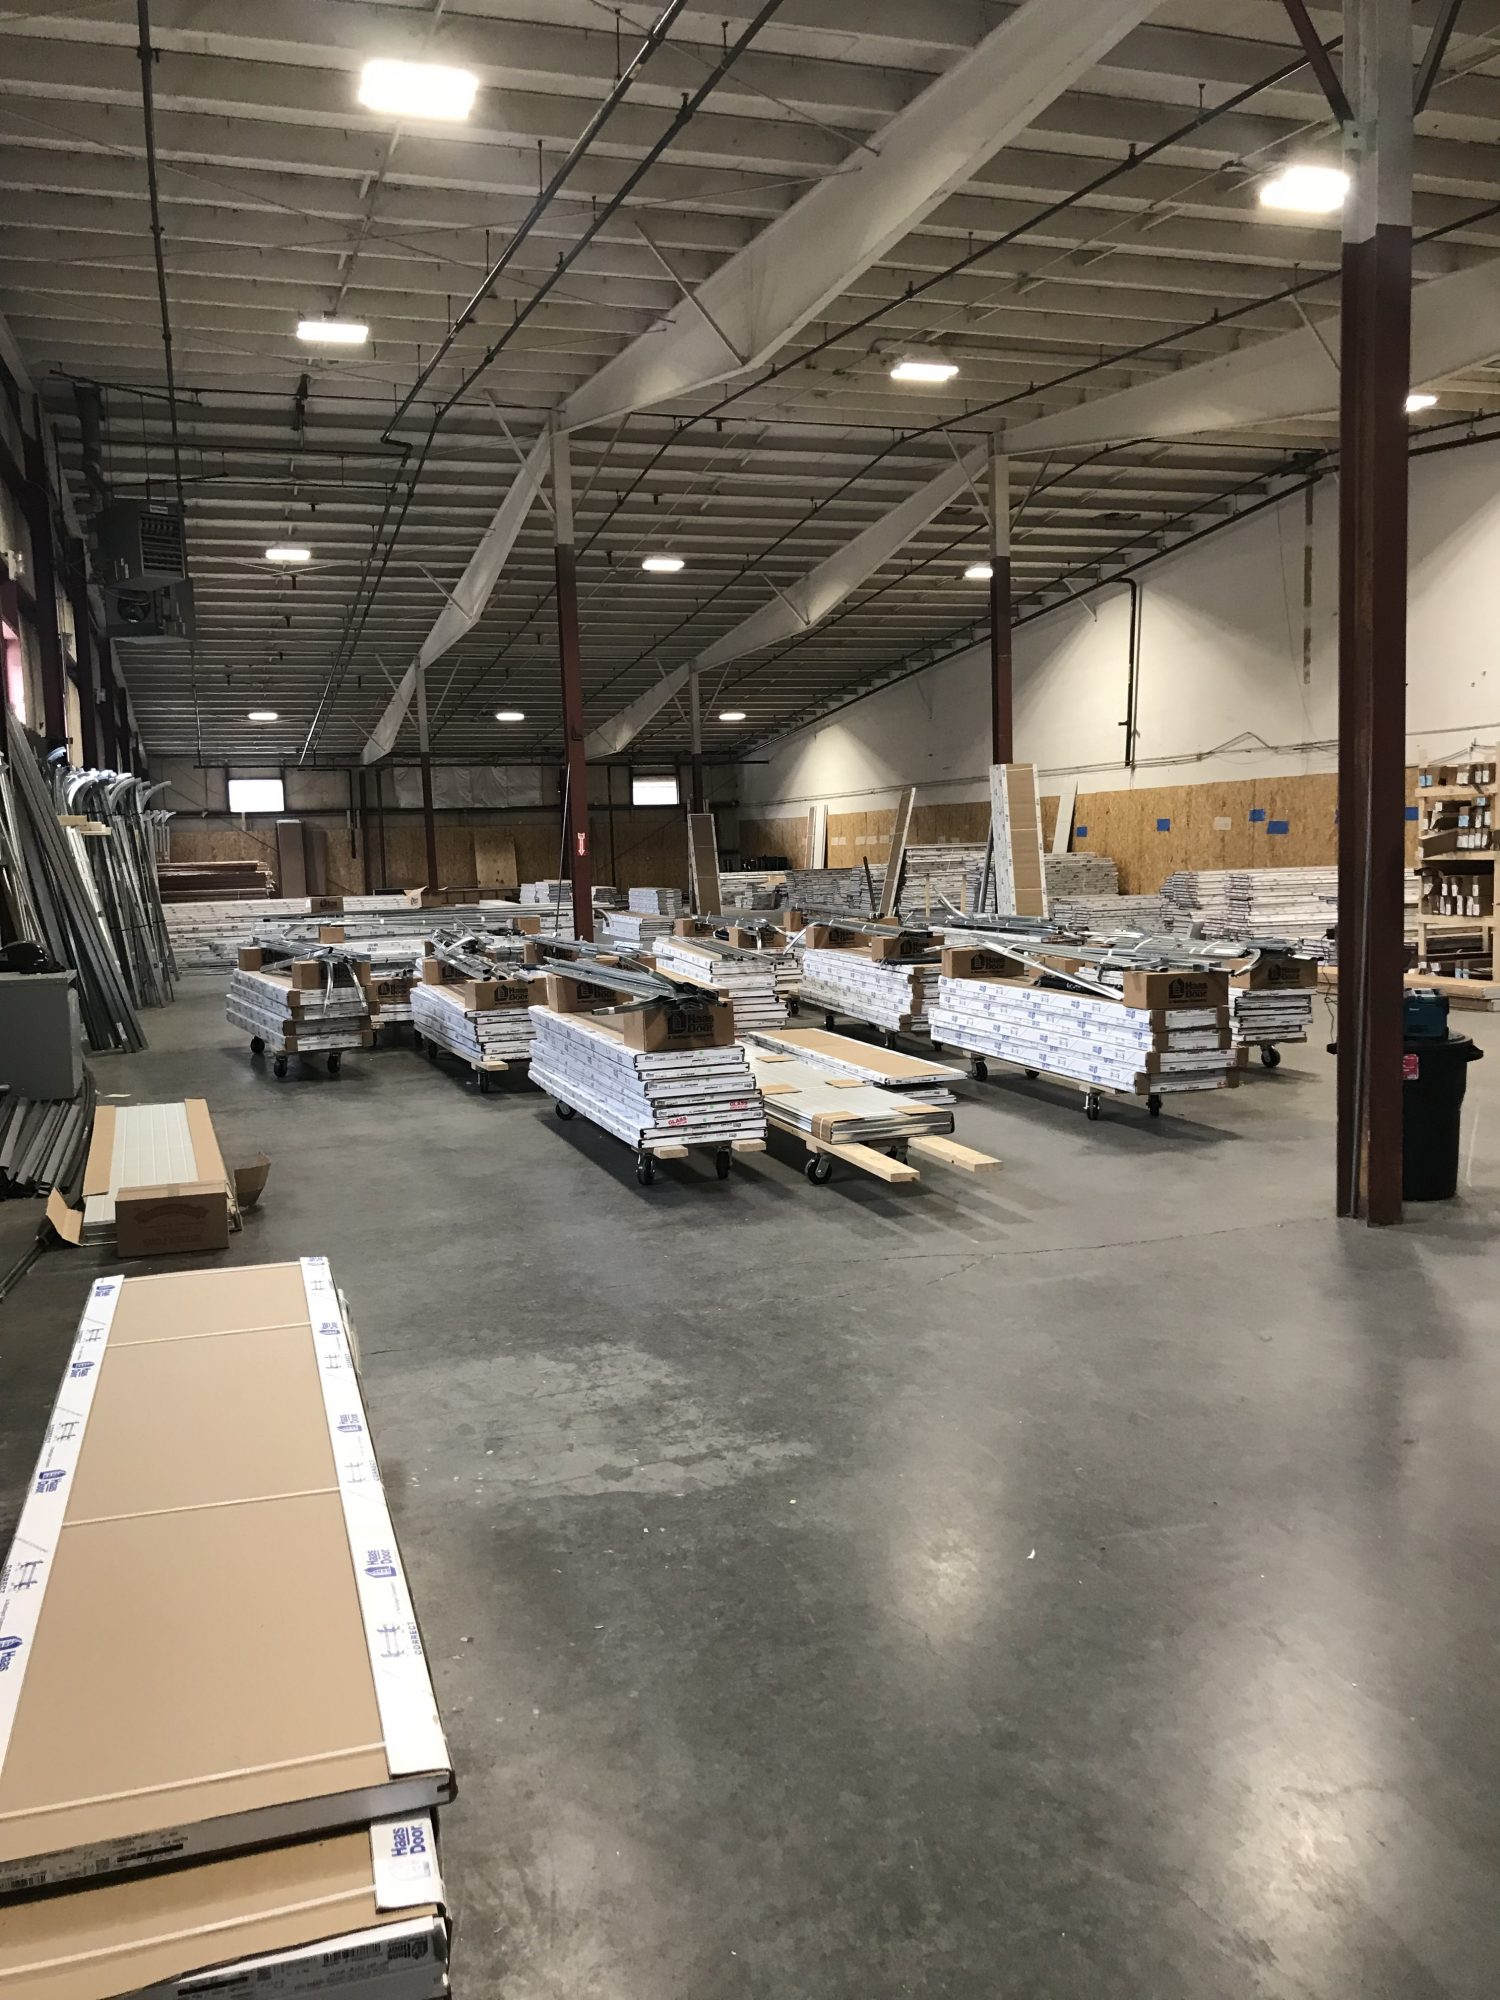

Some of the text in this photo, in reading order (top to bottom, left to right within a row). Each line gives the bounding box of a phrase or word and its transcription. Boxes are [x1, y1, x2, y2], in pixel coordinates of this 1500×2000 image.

[688, 1024, 714, 1032] Door
[668, 1116, 687, 1125] GLASS
[367, 1550, 379, 1565] Haas
[380, 1549, 392, 1564] Door
[407, 1621, 422, 1655] CORRECT
[391, 1827, 407, 1857] Haas
[410, 1825, 426, 1855] Door
